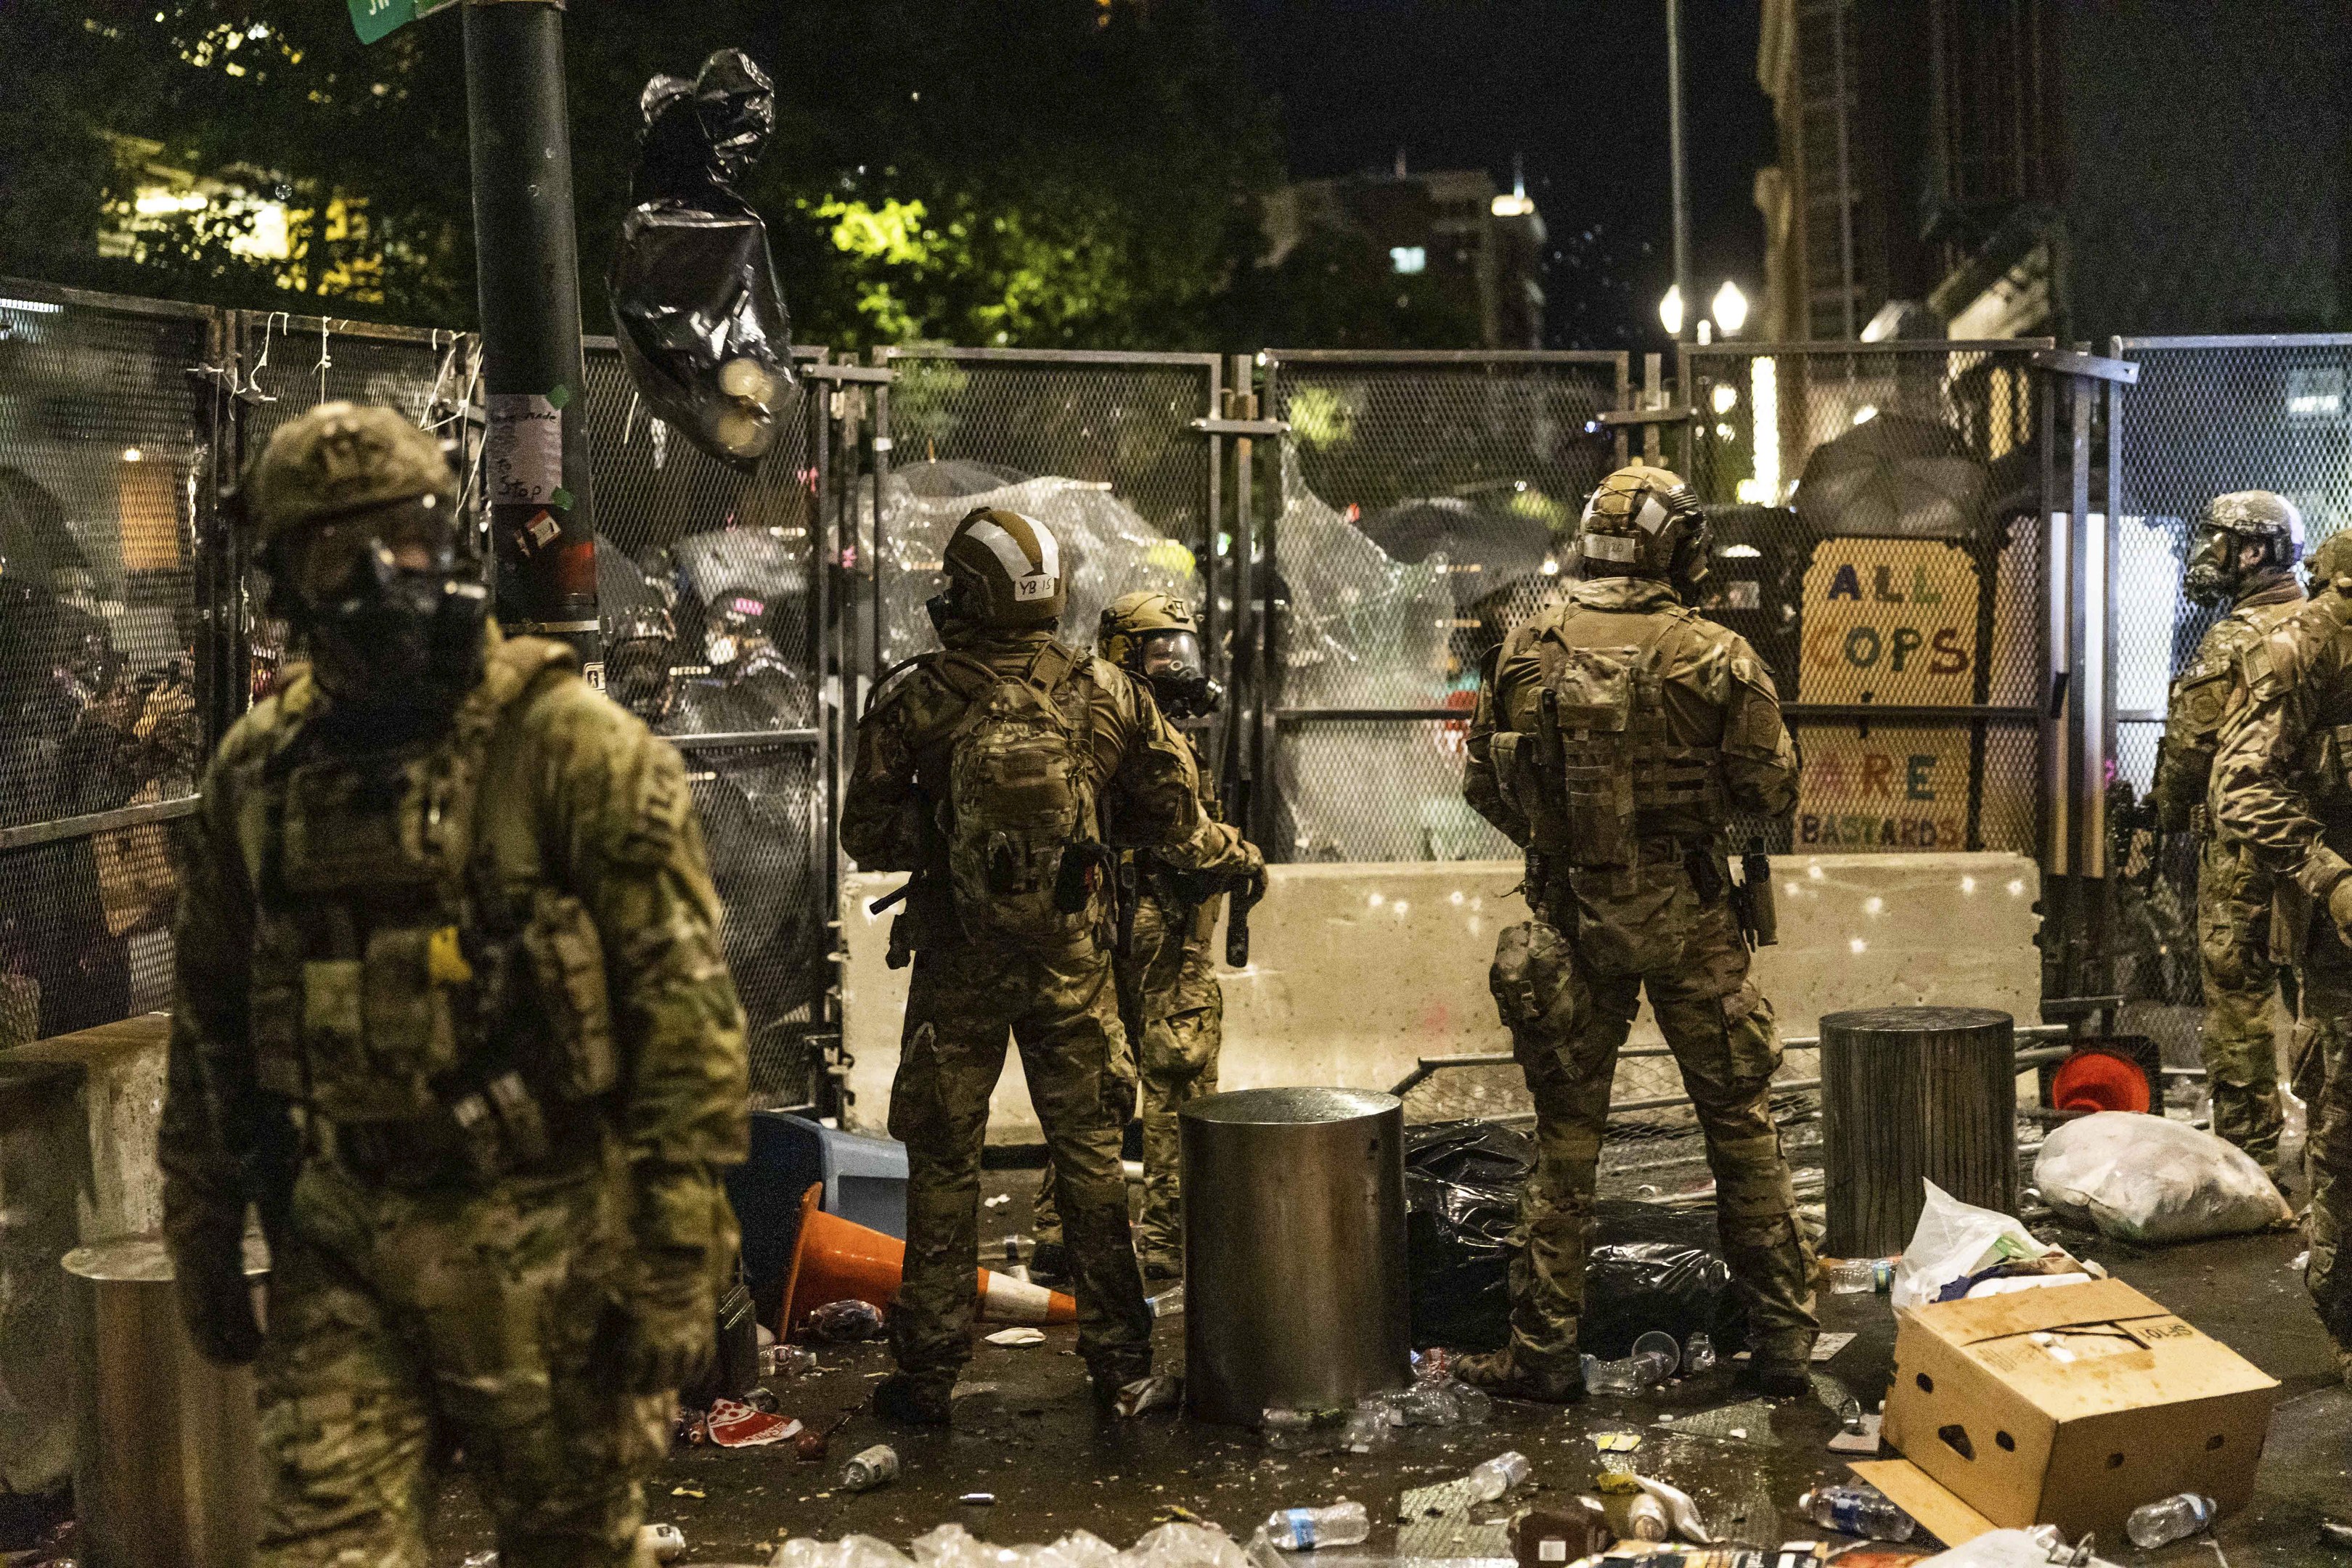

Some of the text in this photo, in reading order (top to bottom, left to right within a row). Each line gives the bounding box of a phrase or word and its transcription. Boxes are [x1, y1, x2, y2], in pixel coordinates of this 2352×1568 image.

[1019, 579, 1037, 595] YB
[1827, 564, 1943, 604] ALL
[1810, 626, 1969, 675] COPS
[1810, 754, 1937, 800] ARE
[1802, 814, 1961, 849] BASTARDS
